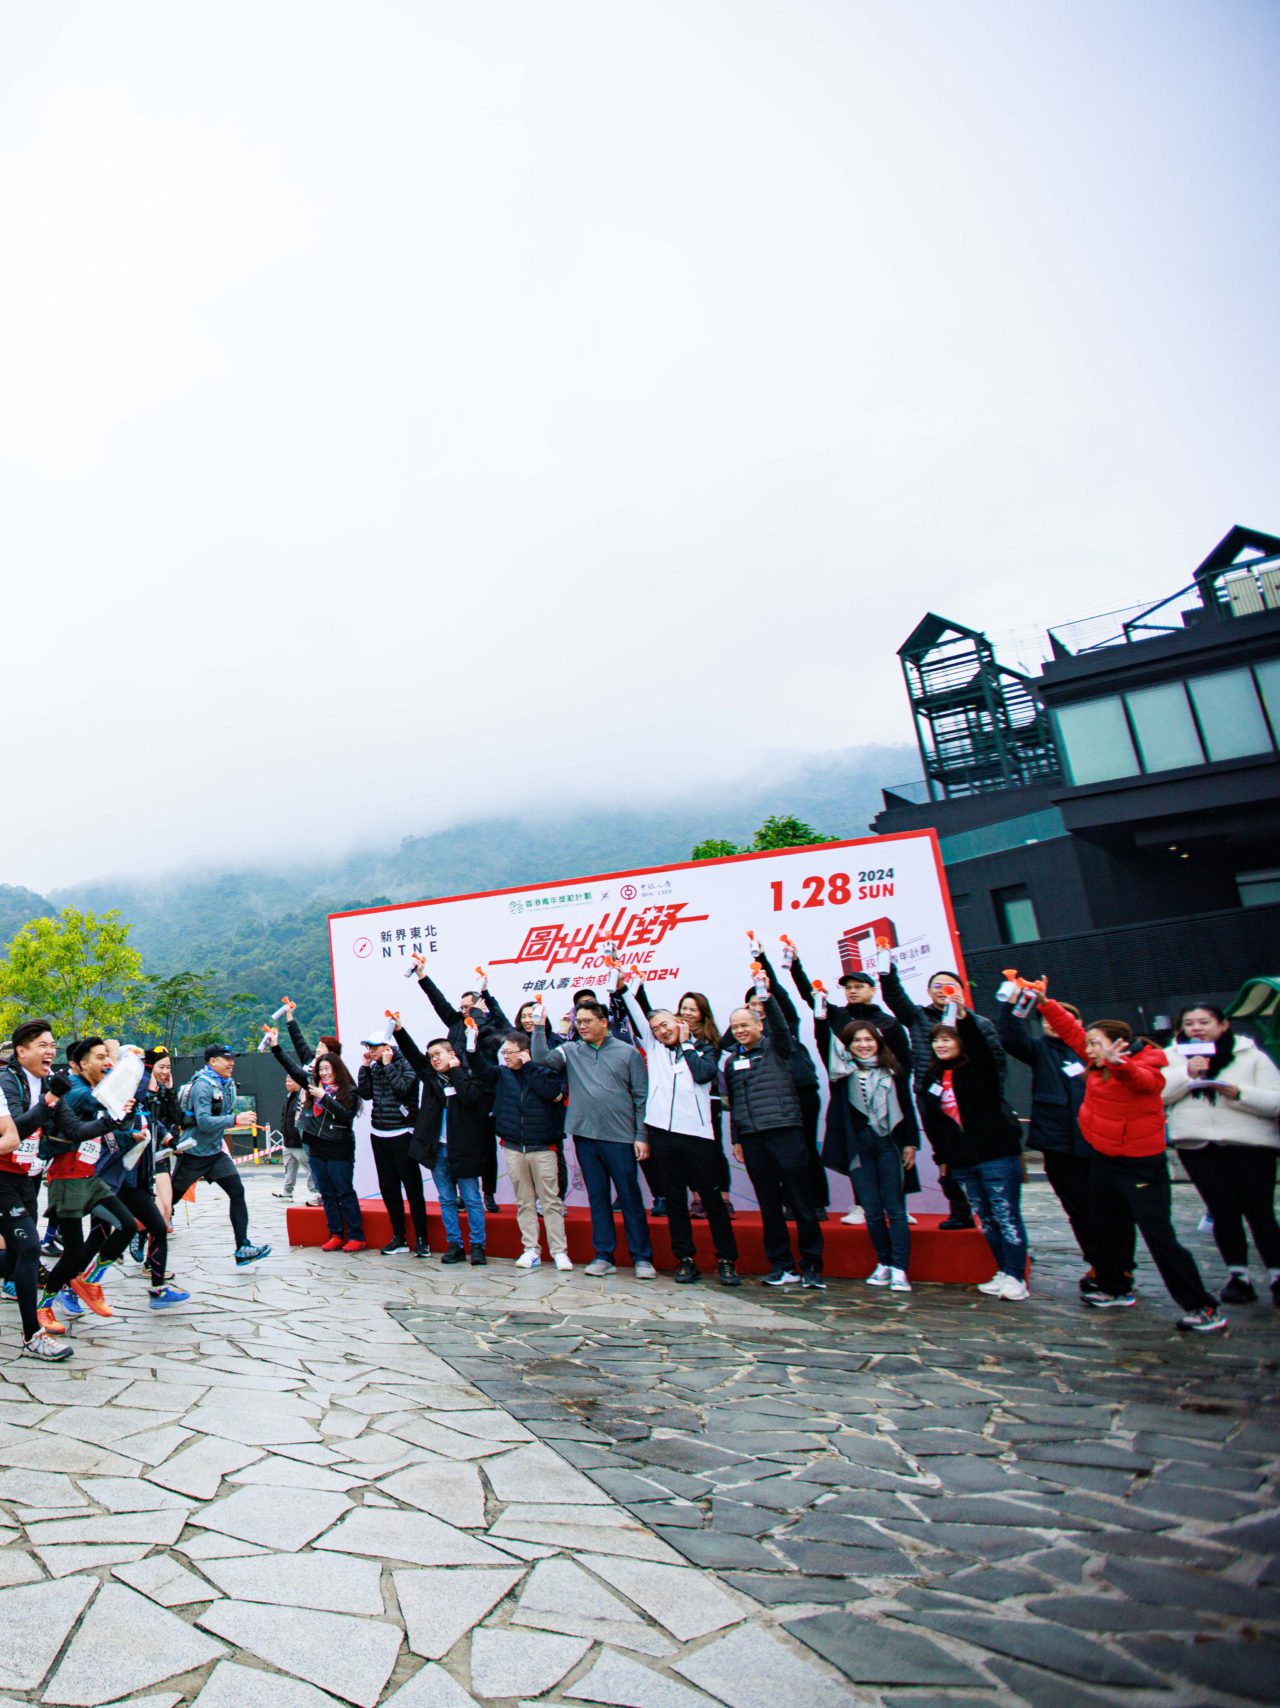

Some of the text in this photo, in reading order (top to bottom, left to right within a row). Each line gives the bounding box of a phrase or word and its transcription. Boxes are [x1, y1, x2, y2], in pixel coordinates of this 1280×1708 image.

[858, 868, 894, 883] 2024
[770, 872, 852, 912] 1.28
[858, 883, 894, 900] SUN
[380, 924, 438, 943] 新界東北
[581, 950, 656, 970] ROAINE
